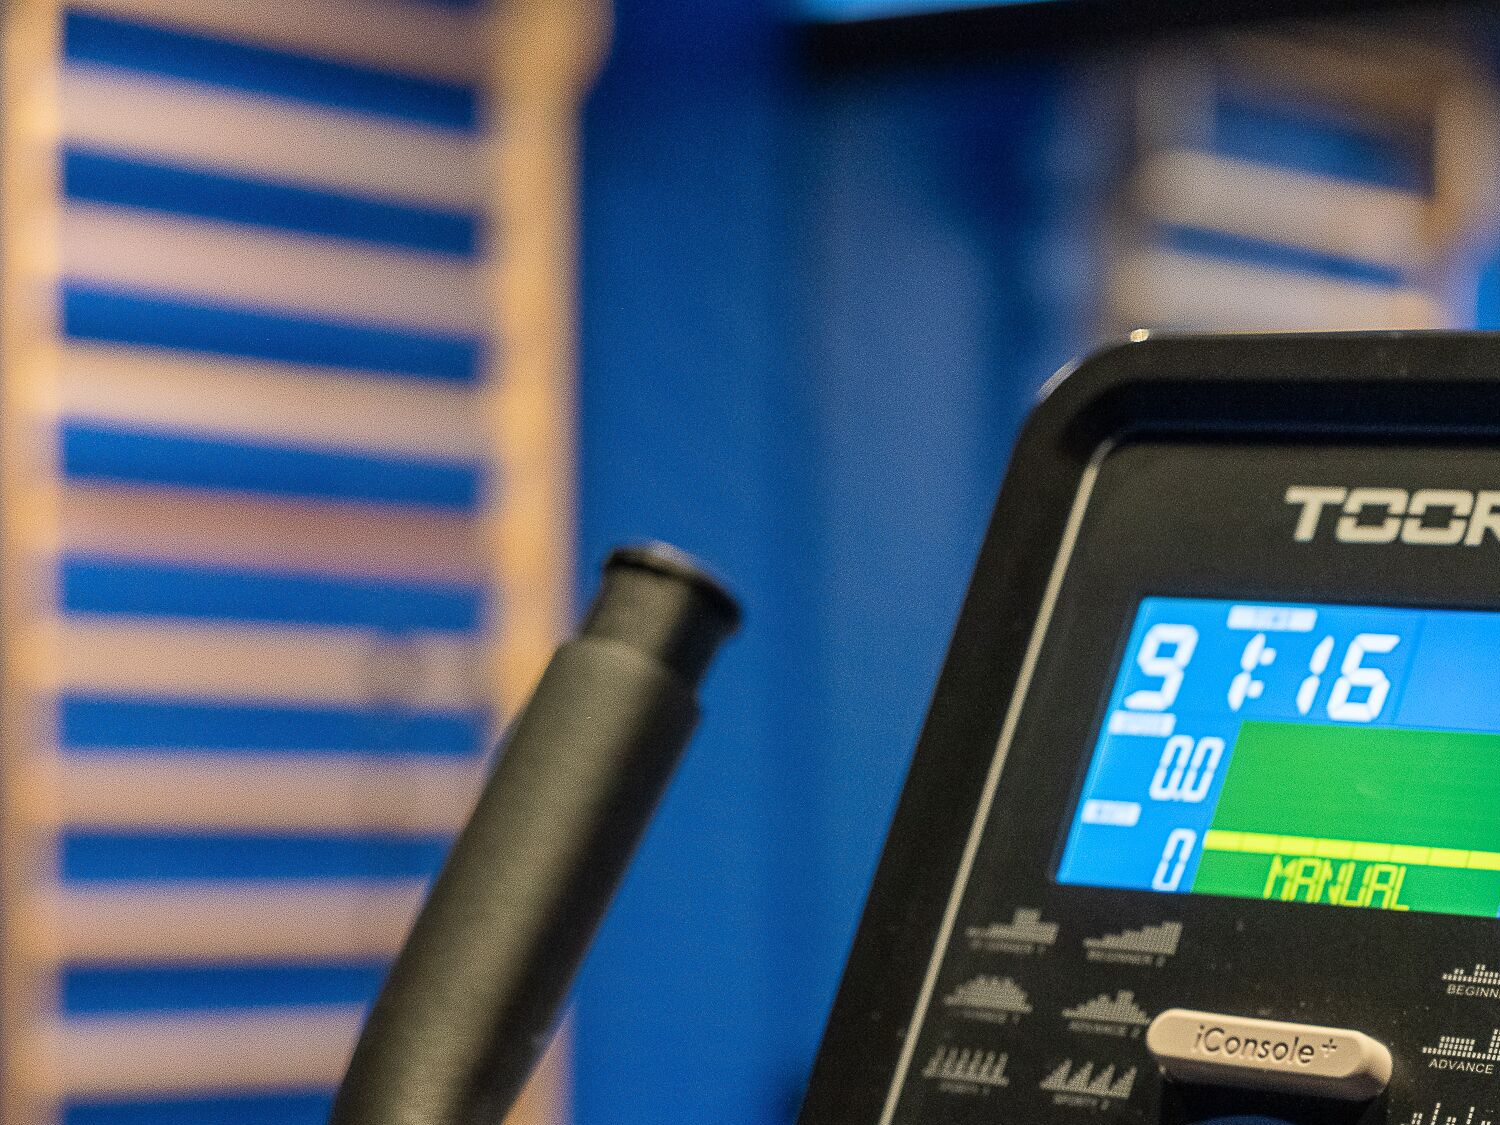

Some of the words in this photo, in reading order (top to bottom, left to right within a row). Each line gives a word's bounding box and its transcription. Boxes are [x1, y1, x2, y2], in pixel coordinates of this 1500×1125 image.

[1152, 828, 1197, 891] 0
[1263, 855, 1409, 911] MANUAL
[1428, 1059, 1494, 1075] ADVANCE
